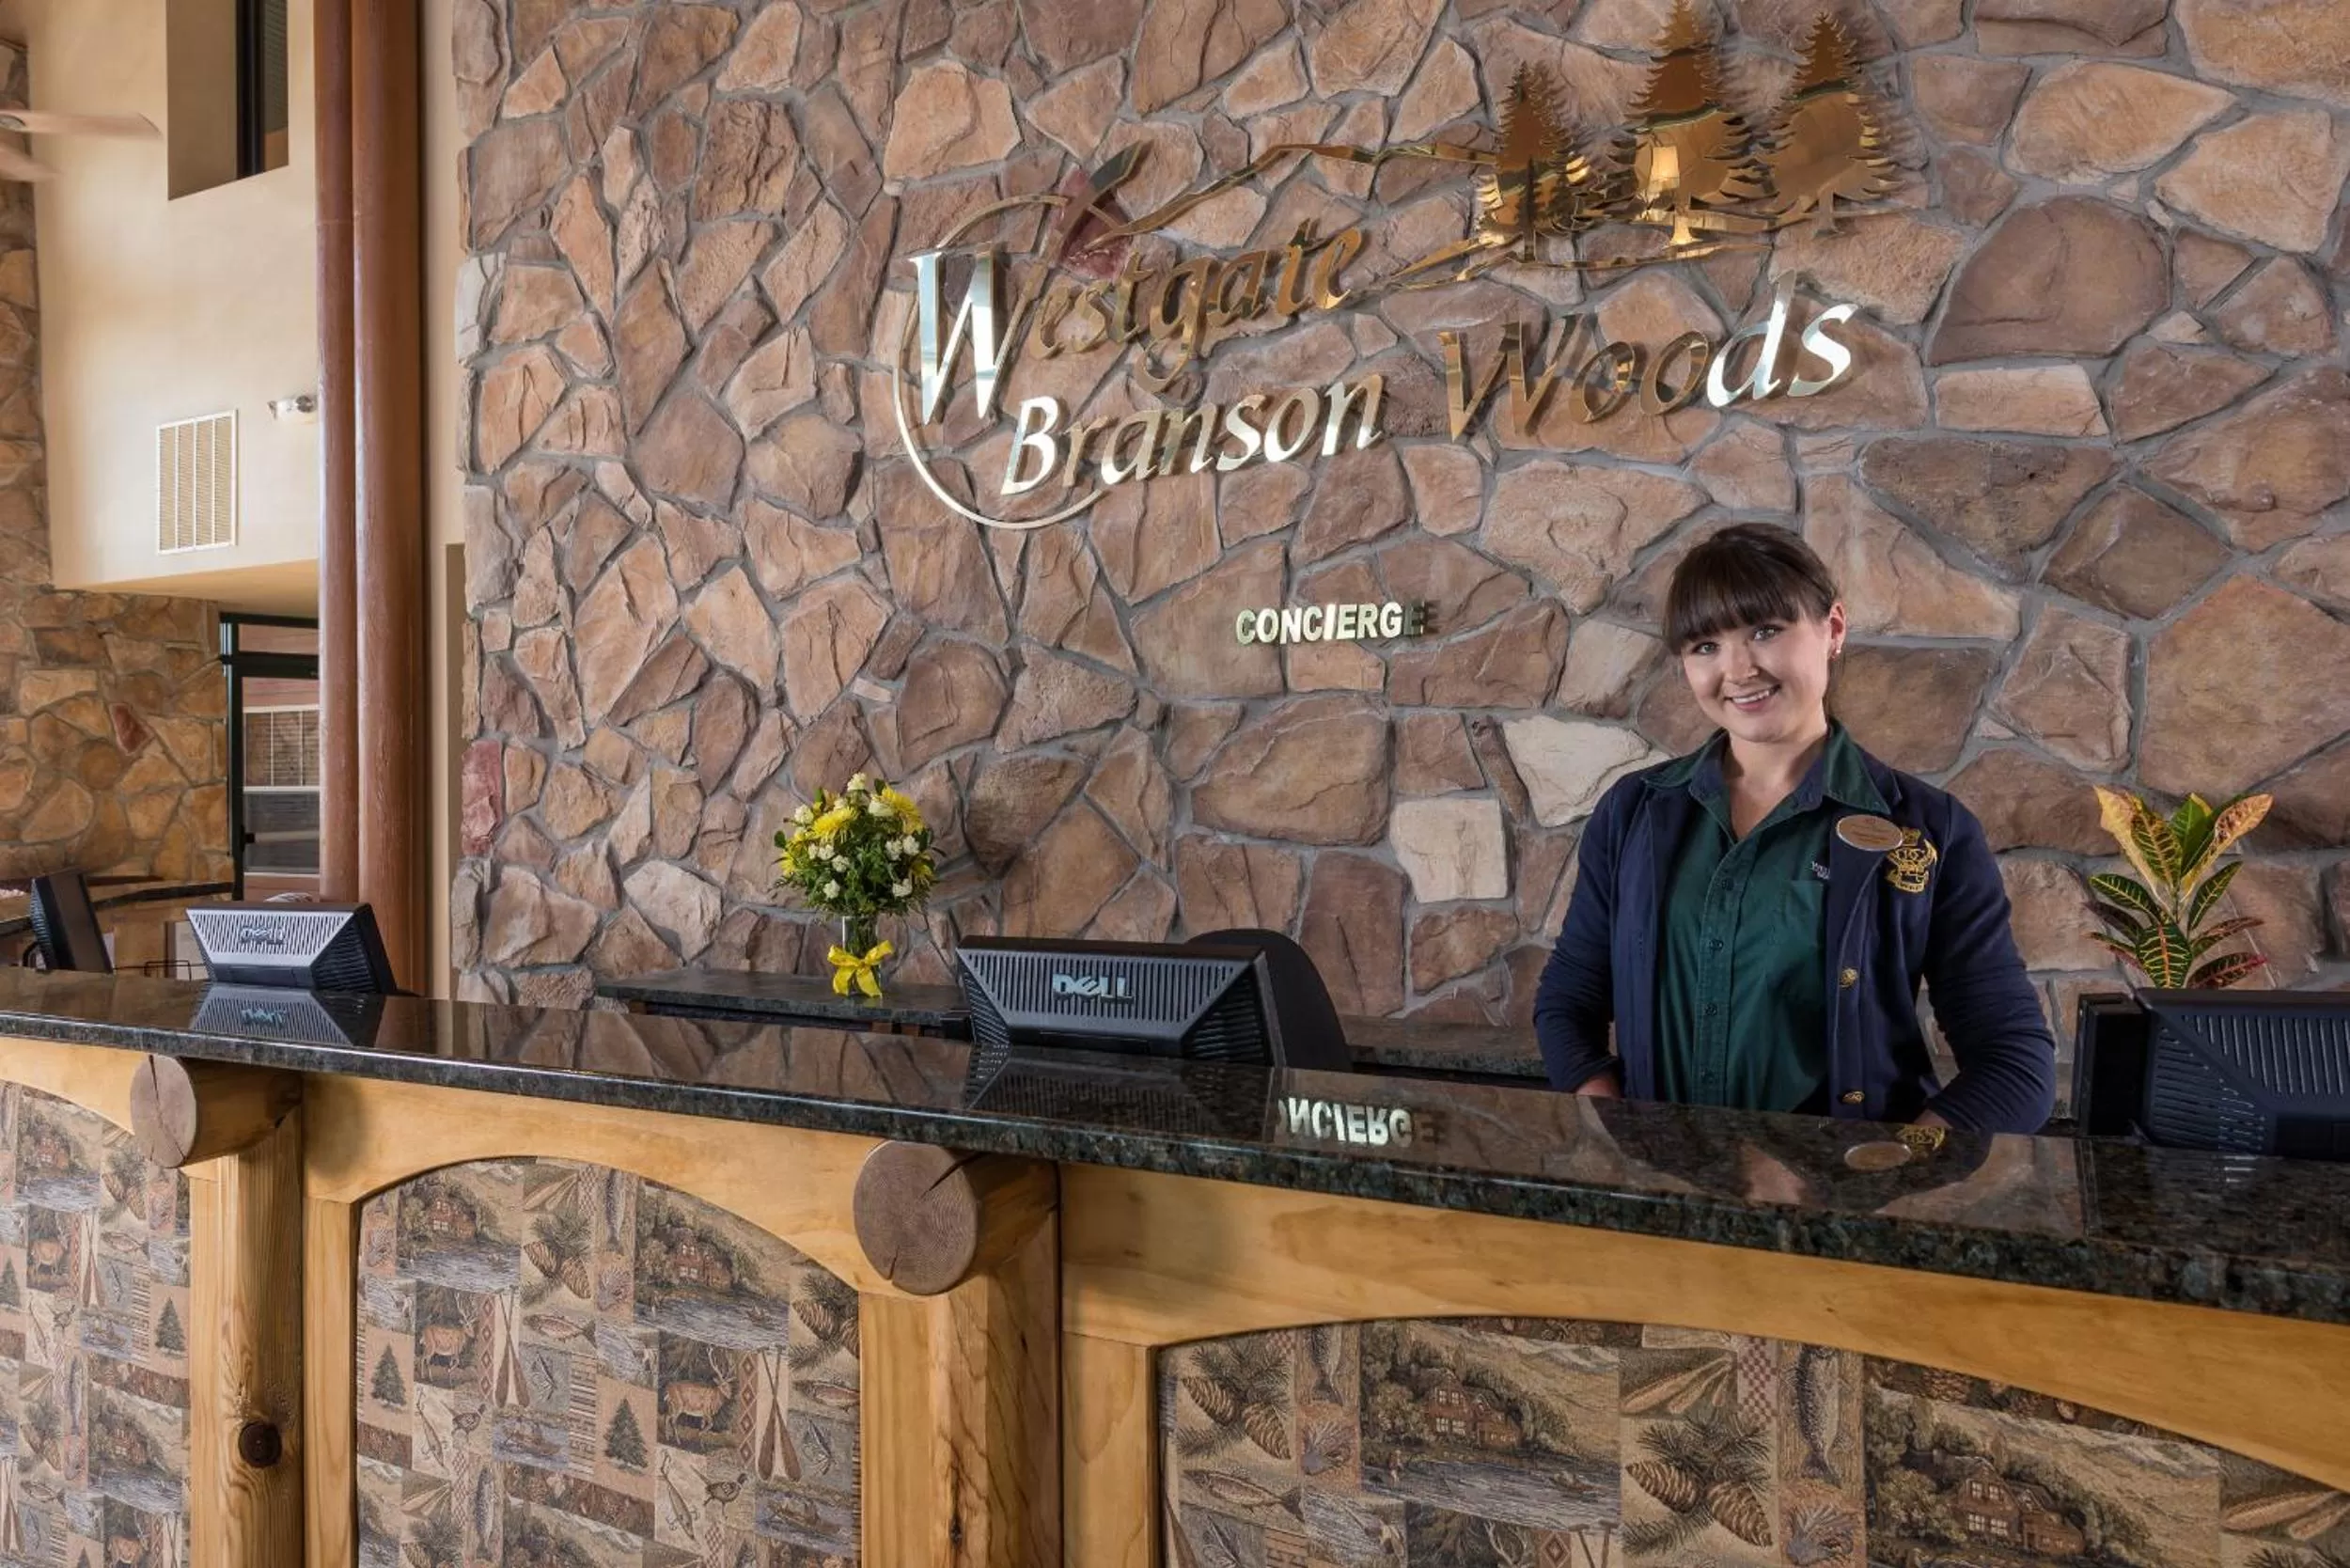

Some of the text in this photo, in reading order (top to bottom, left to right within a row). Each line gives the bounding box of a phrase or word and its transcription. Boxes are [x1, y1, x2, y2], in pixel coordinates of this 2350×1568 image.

[909, 217, 1363, 425] Westgate
[1000, 269, 1859, 495] Branson Woods
[1235, 600, 1426, 645] CONCIERGE
[1052, 973, 1133, 1000] DELL
